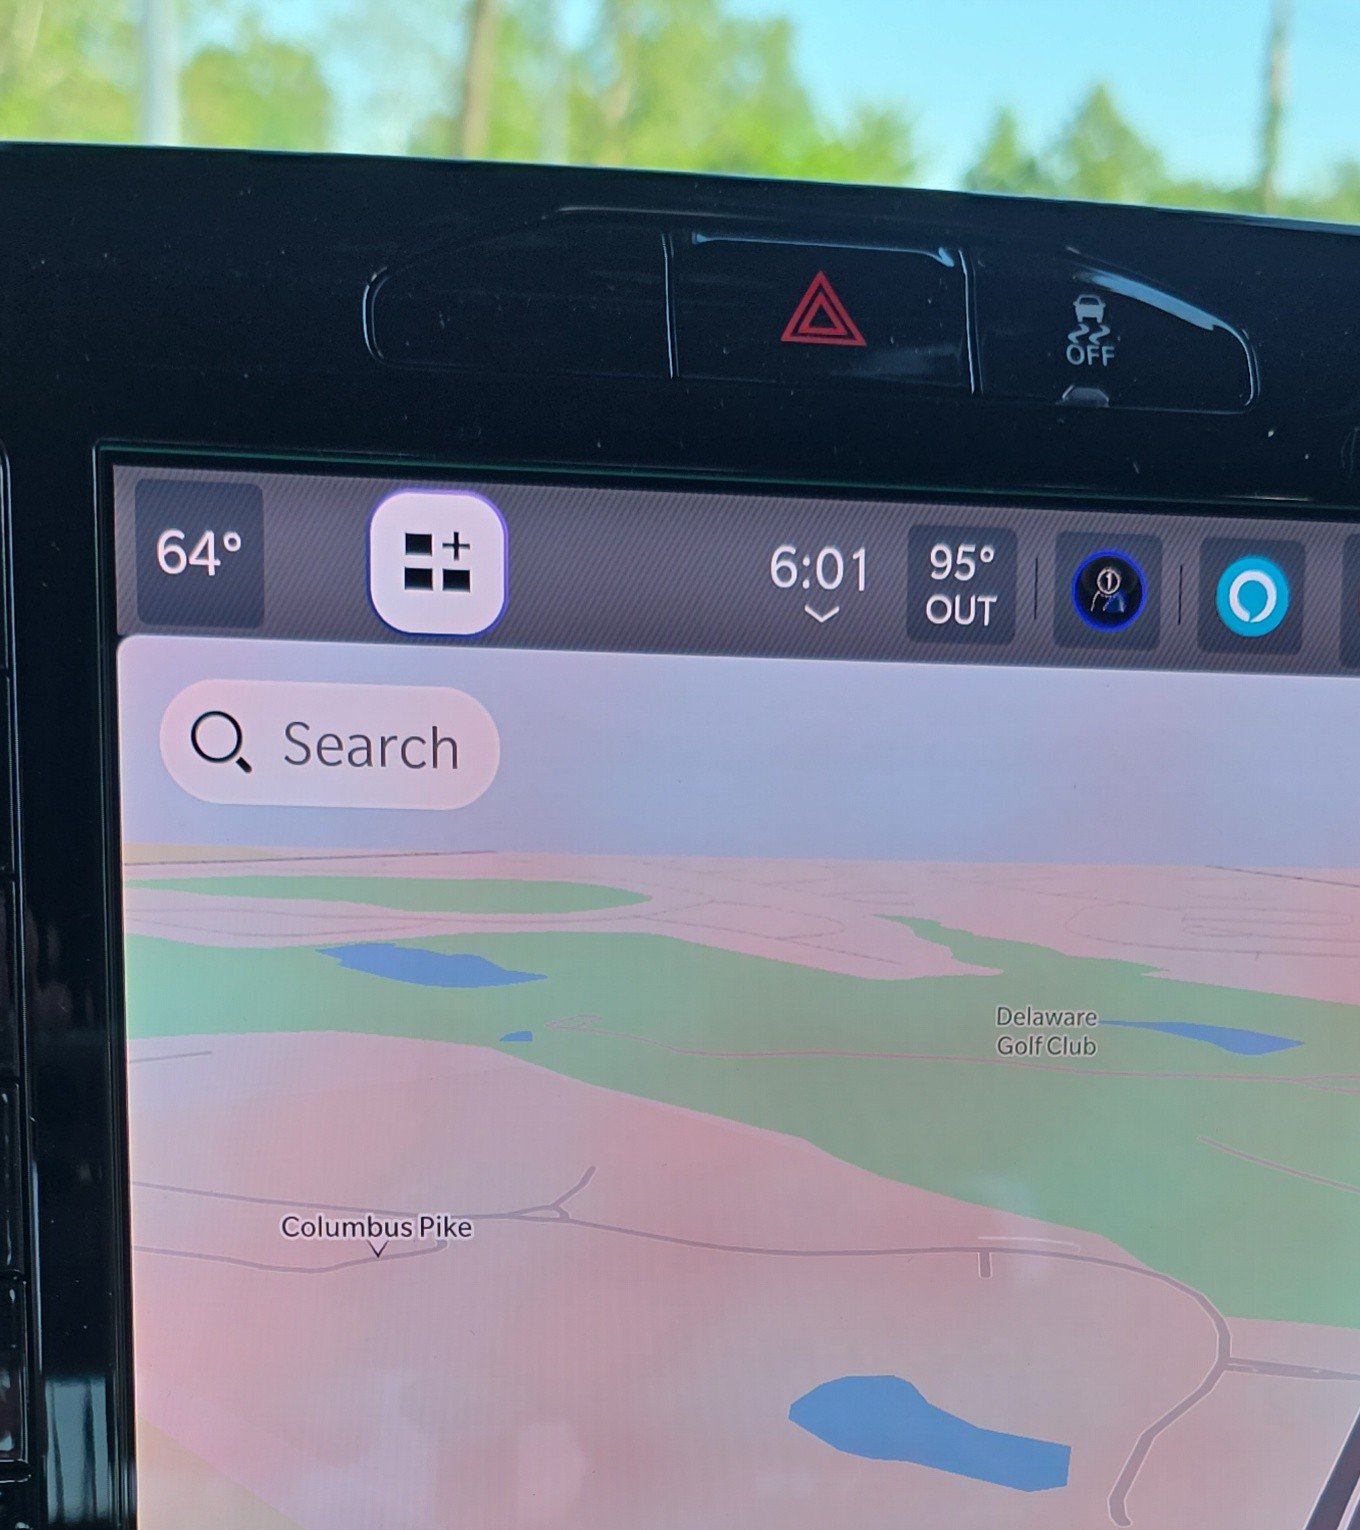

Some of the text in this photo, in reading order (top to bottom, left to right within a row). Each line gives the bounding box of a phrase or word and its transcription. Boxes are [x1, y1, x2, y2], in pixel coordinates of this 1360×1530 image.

[1065, 343, 1115, 367] OFF
[155, 527, 242, 577] 64°
[769, 544, 868, 592] 6:01
[928, 543, 996, 582] 95°
[924, 594, 998, 627] OUT
[283, 720, 460, 770] Search
[996, 1006, 1098, 1027] Delaware
[996, 1036, 1097, 1056] Golf Club
[281, 1215, 473, 1238] Columbus Pike
